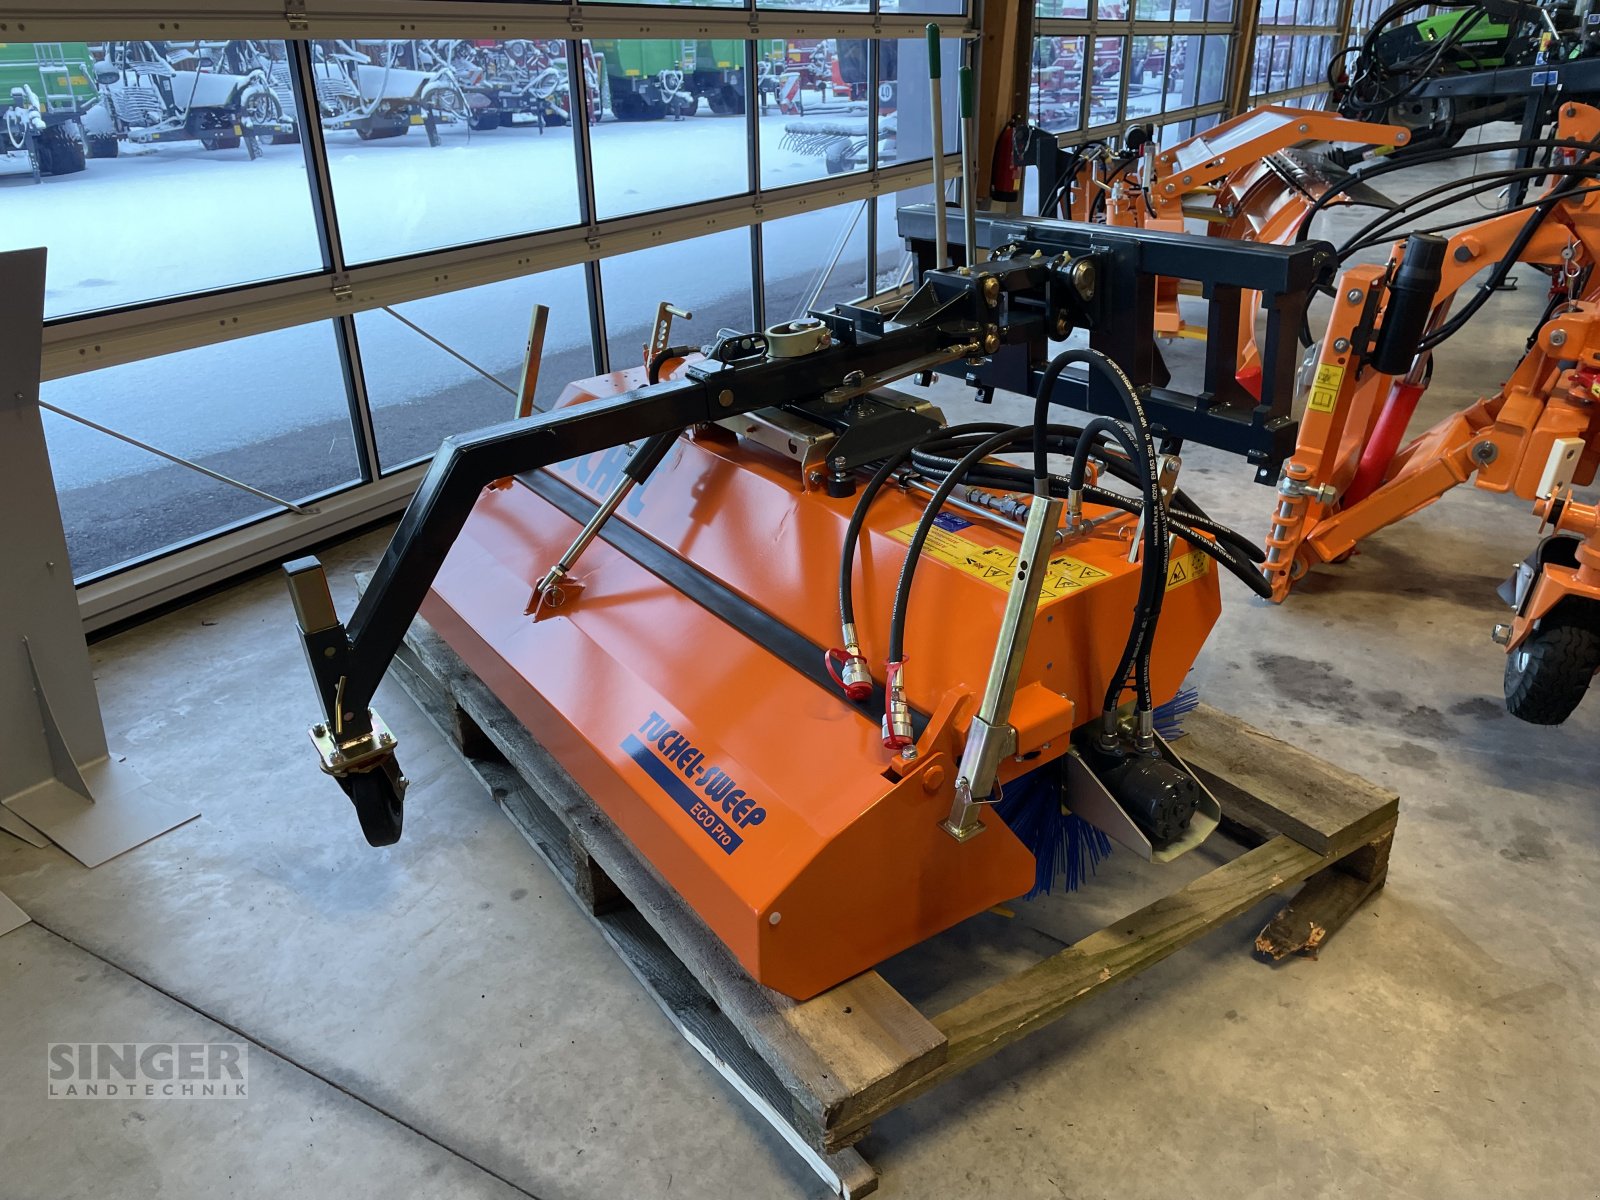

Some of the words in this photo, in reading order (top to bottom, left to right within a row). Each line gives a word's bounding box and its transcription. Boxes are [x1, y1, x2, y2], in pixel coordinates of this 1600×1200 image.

[881, 86, 890, 98] 40
[1131, 392, 1140, 406] BAR
[1140, 416, 1148, 428] WP
[1144, 433, 1151, 441] 10
[638, 711, 767, 829] TUCHEL-SWEEP
[689, 802, 716, 827] ECO
[711, 823, 732, 846] Pro
